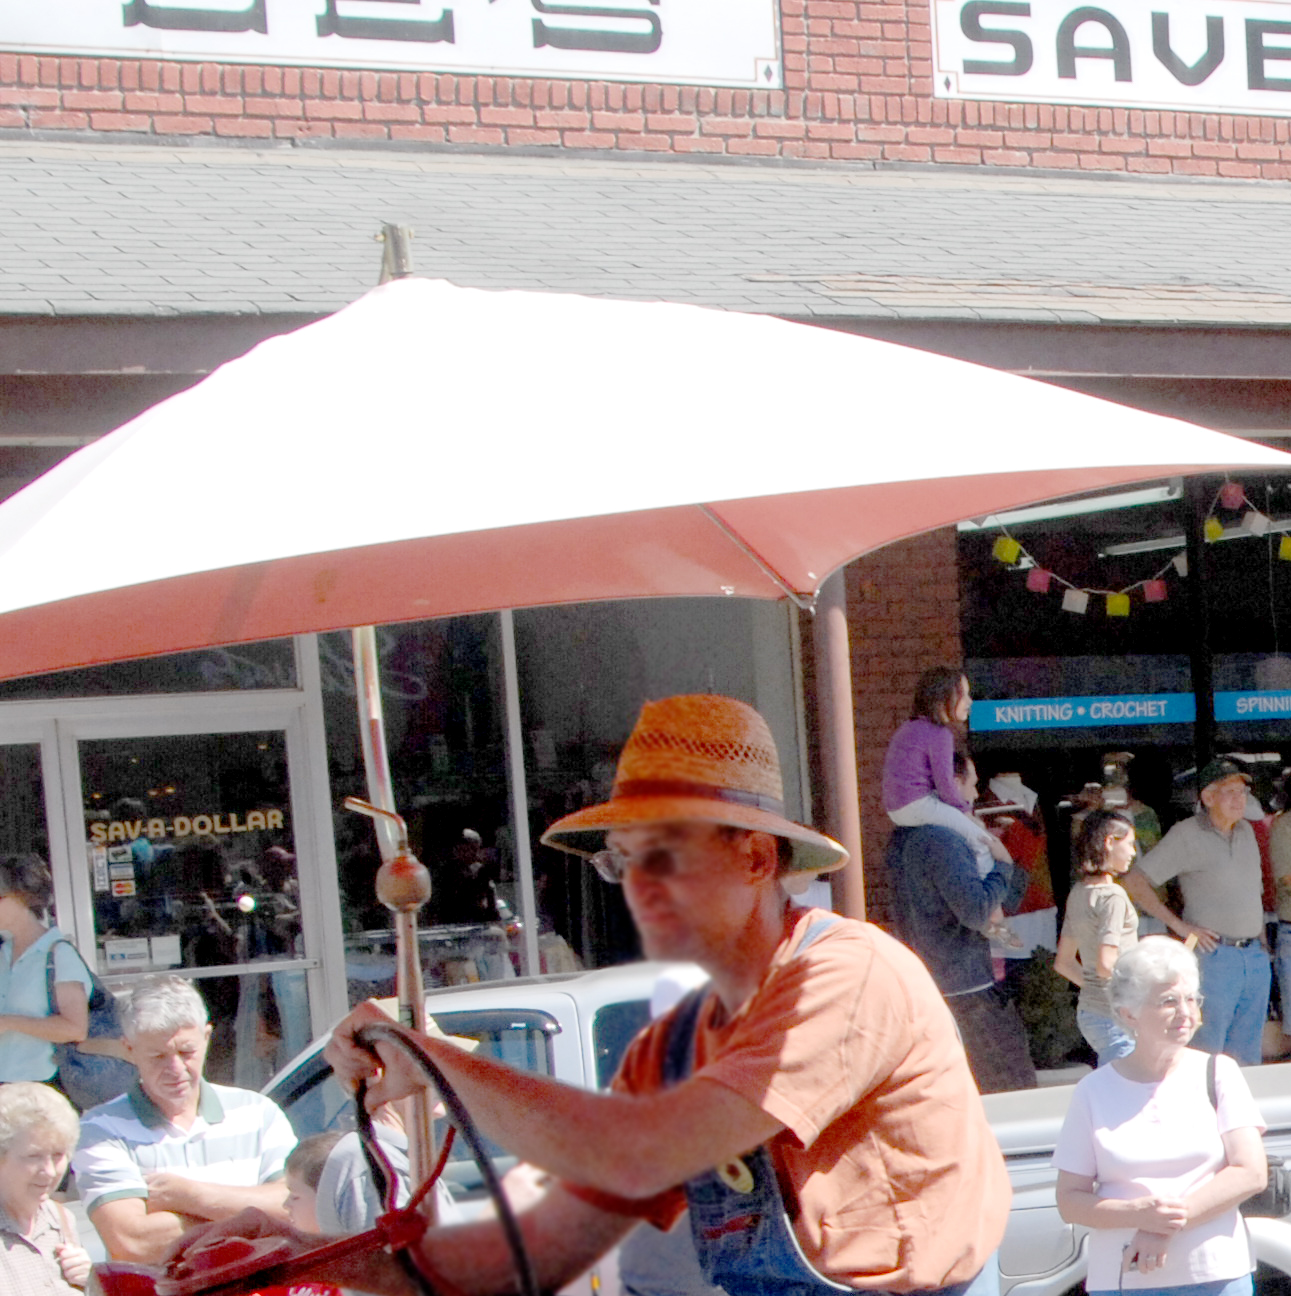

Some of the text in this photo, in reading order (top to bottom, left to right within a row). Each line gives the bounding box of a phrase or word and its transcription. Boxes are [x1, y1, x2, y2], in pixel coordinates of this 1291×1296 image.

[994, 700, 1168, 724] KNITTING CROCHET
[90, 809, 285, 842] SAV-A-DOLLAR
